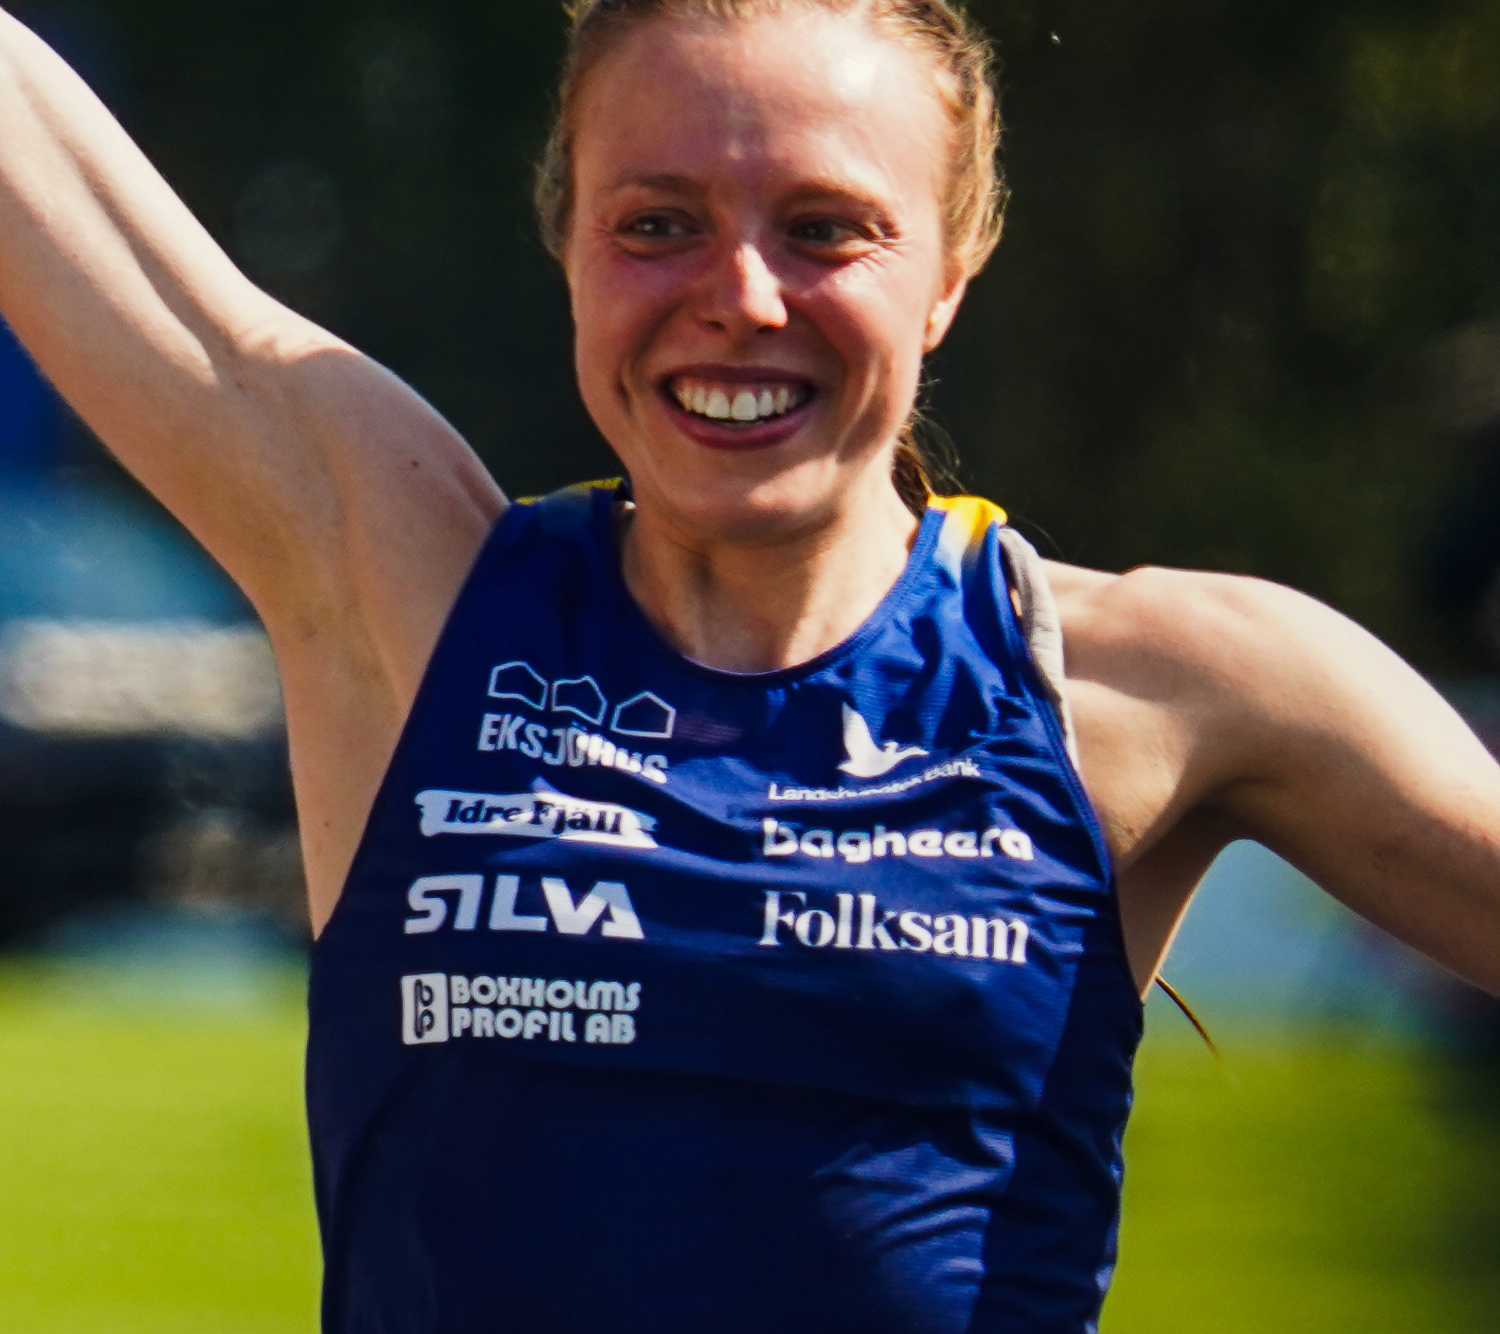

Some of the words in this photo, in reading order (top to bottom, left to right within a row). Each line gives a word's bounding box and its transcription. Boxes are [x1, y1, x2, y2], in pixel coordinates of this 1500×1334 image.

[476, 712, 669, 784] EKSJÖHUS
[443, 799, 524, 824] Idre
[528, 800, 624, 835] Fjäll
[762, 817, 1034, 863] bagheera
[403, 873, 646, 940] SILVA
[755, 889, 1030, 964] Folksam
[450, 974, 642, 1012] BOXHOLMS
[451, 1007, 577, 1043] PROFIL
[584, 1012, 637, 1045] AB
